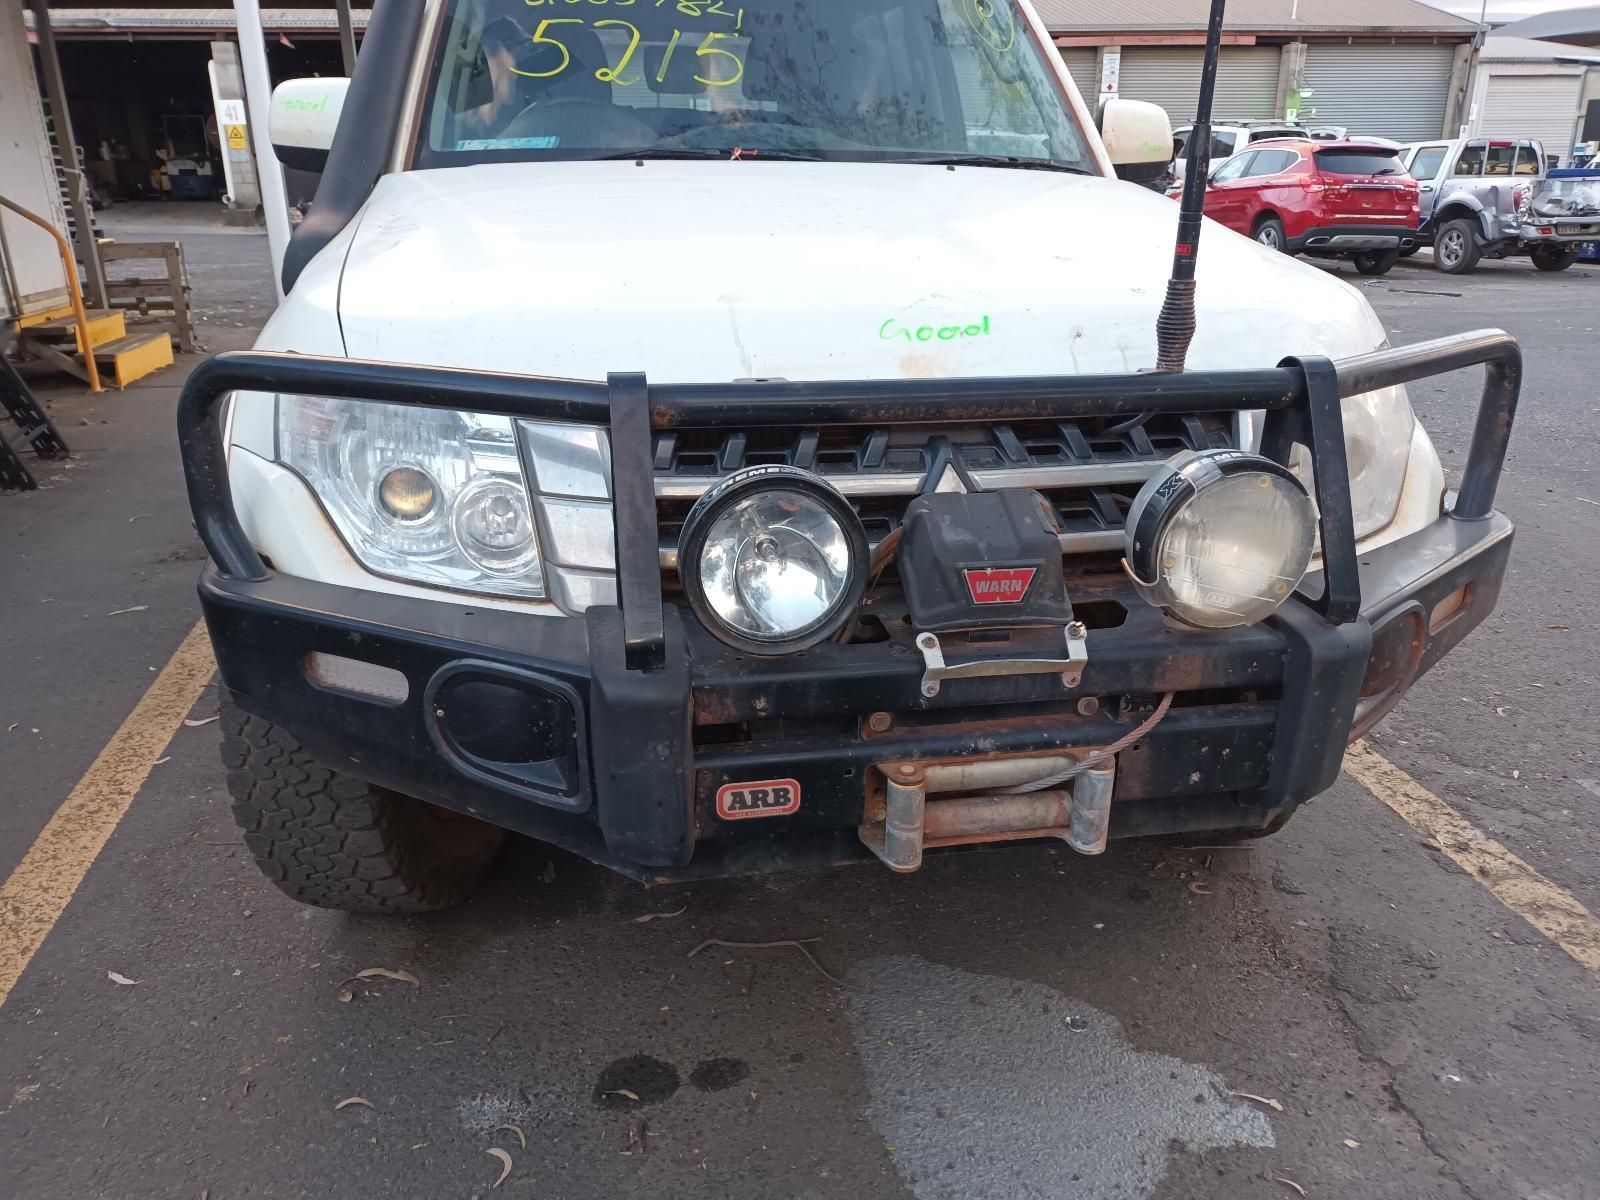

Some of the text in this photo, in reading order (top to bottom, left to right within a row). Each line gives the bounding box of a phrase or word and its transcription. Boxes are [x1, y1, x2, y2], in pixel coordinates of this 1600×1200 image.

[510, 18, 744, 86] 5215
[879, 314, 990, 341] Good
[975, 579, 1022, 594] WARN
[727, 787, 792, 811] ARB
